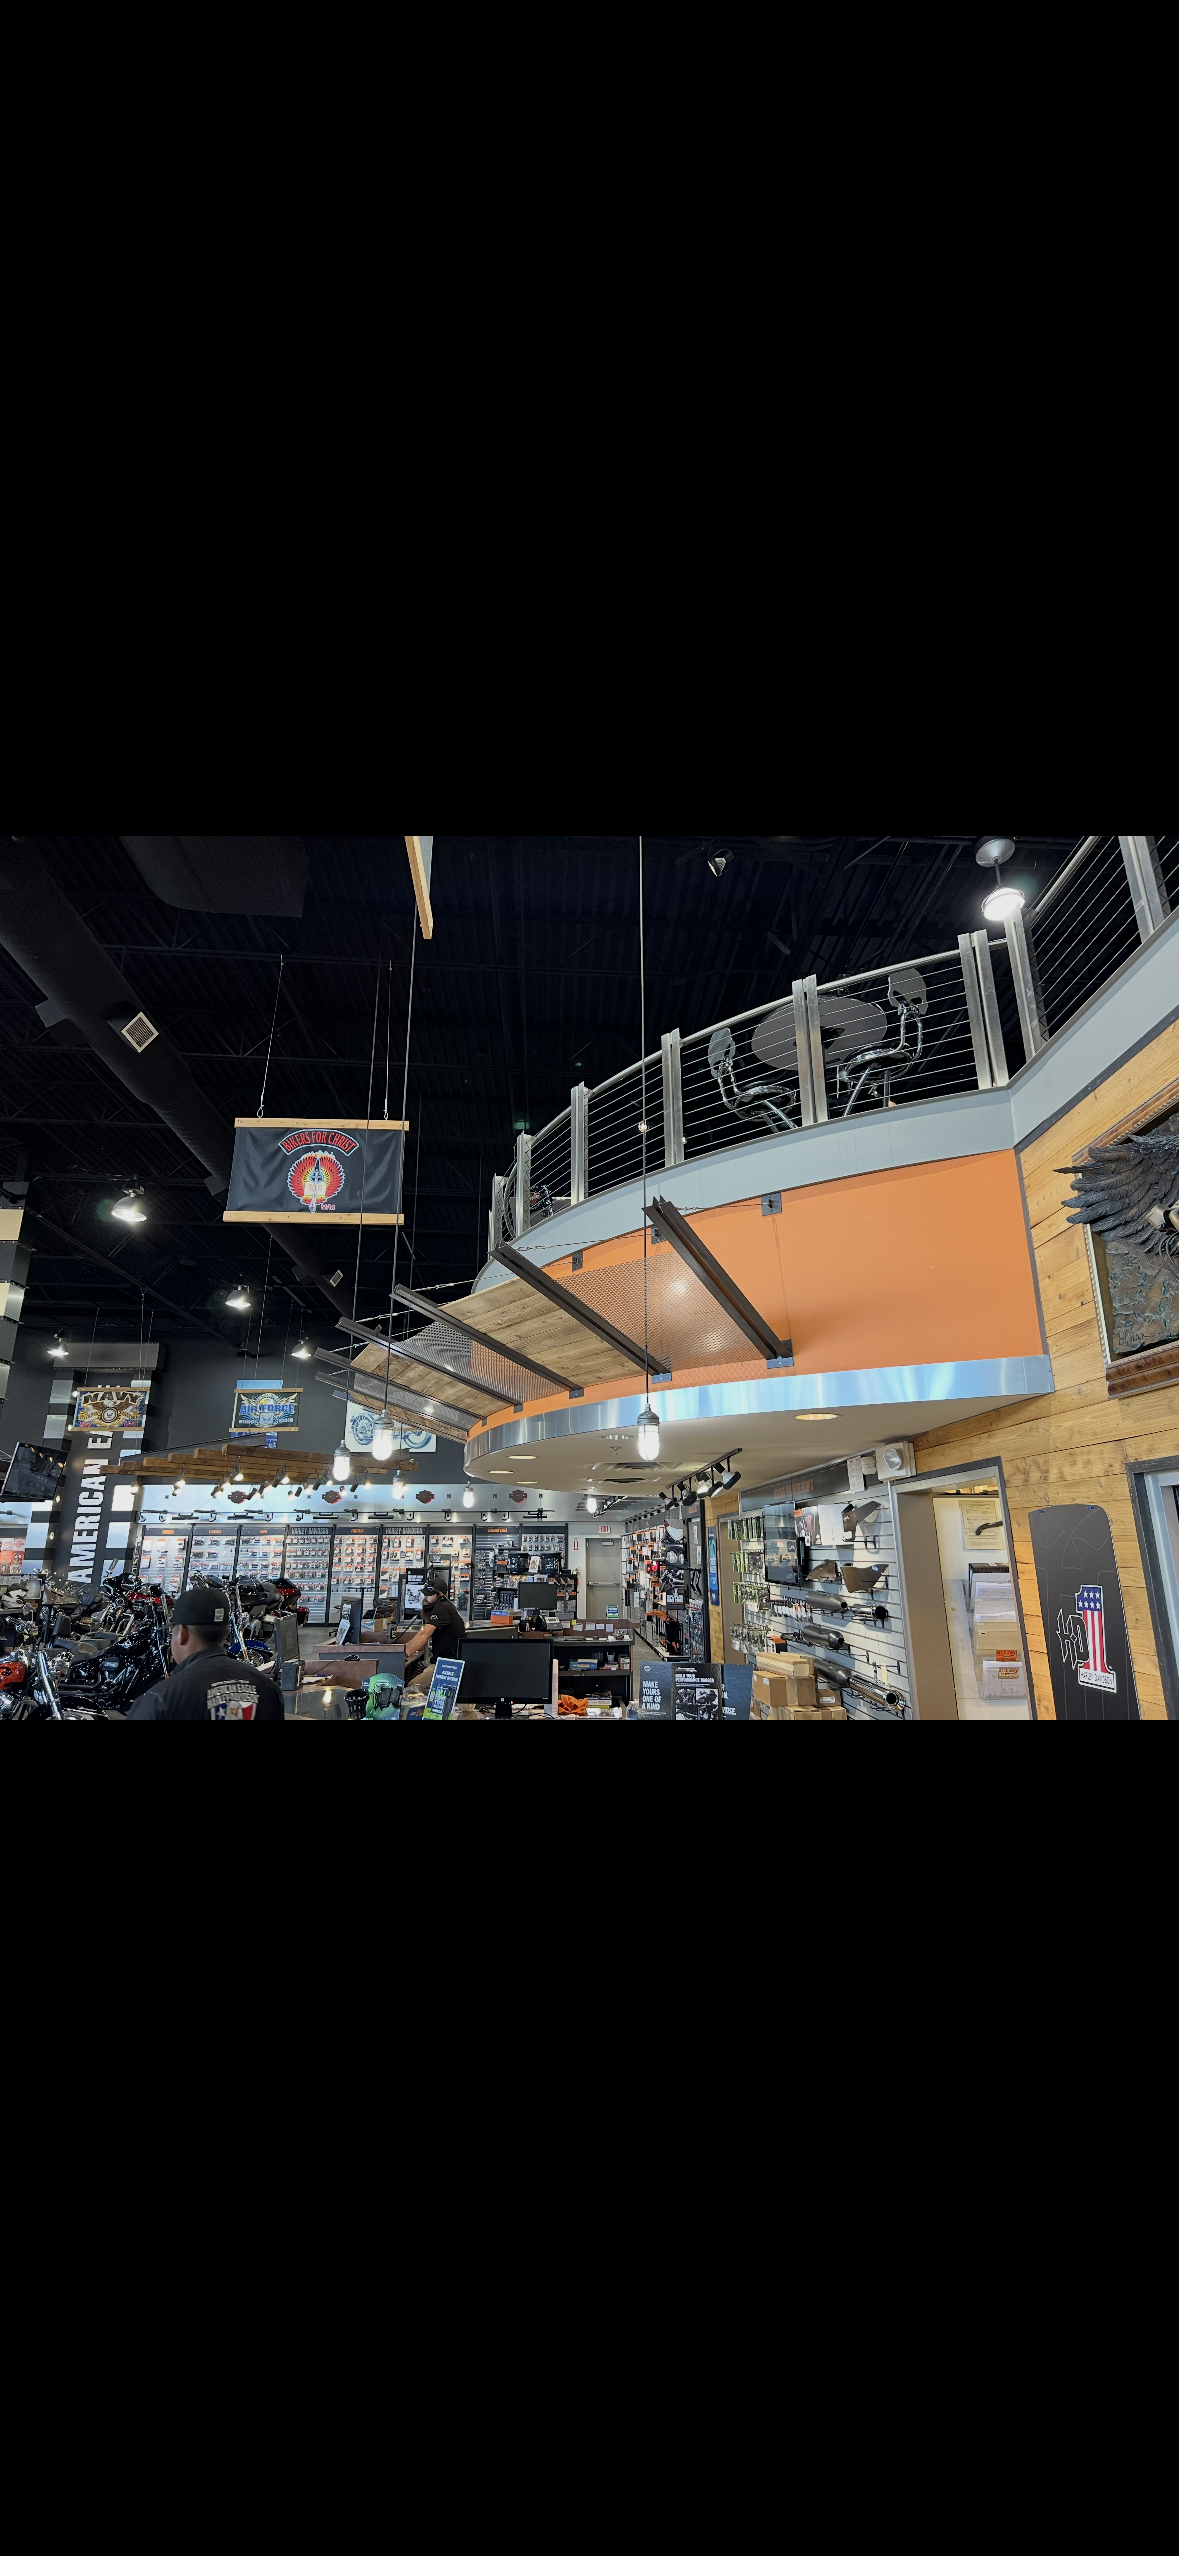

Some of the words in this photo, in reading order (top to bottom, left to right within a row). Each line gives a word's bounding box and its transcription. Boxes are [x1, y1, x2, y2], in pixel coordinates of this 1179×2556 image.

[281, 1131, 311, 1152] BIKERS
[311, 1131, 328, 1144] FOR
[328, 1132, 357, 1152] CHRIST
[82, 1391, 143, 1405] NAVY
[239, 1403, 258, 1416] AIR
[260, 1402, 296, 1415] FORCE
[67, 1458, 109, 1584] AMERICAN
[643, 1681, 659, 1689] MAKE
[643, 1688, 661, 1696] YOURS
[647, 1703, 660, 1711] KIND
